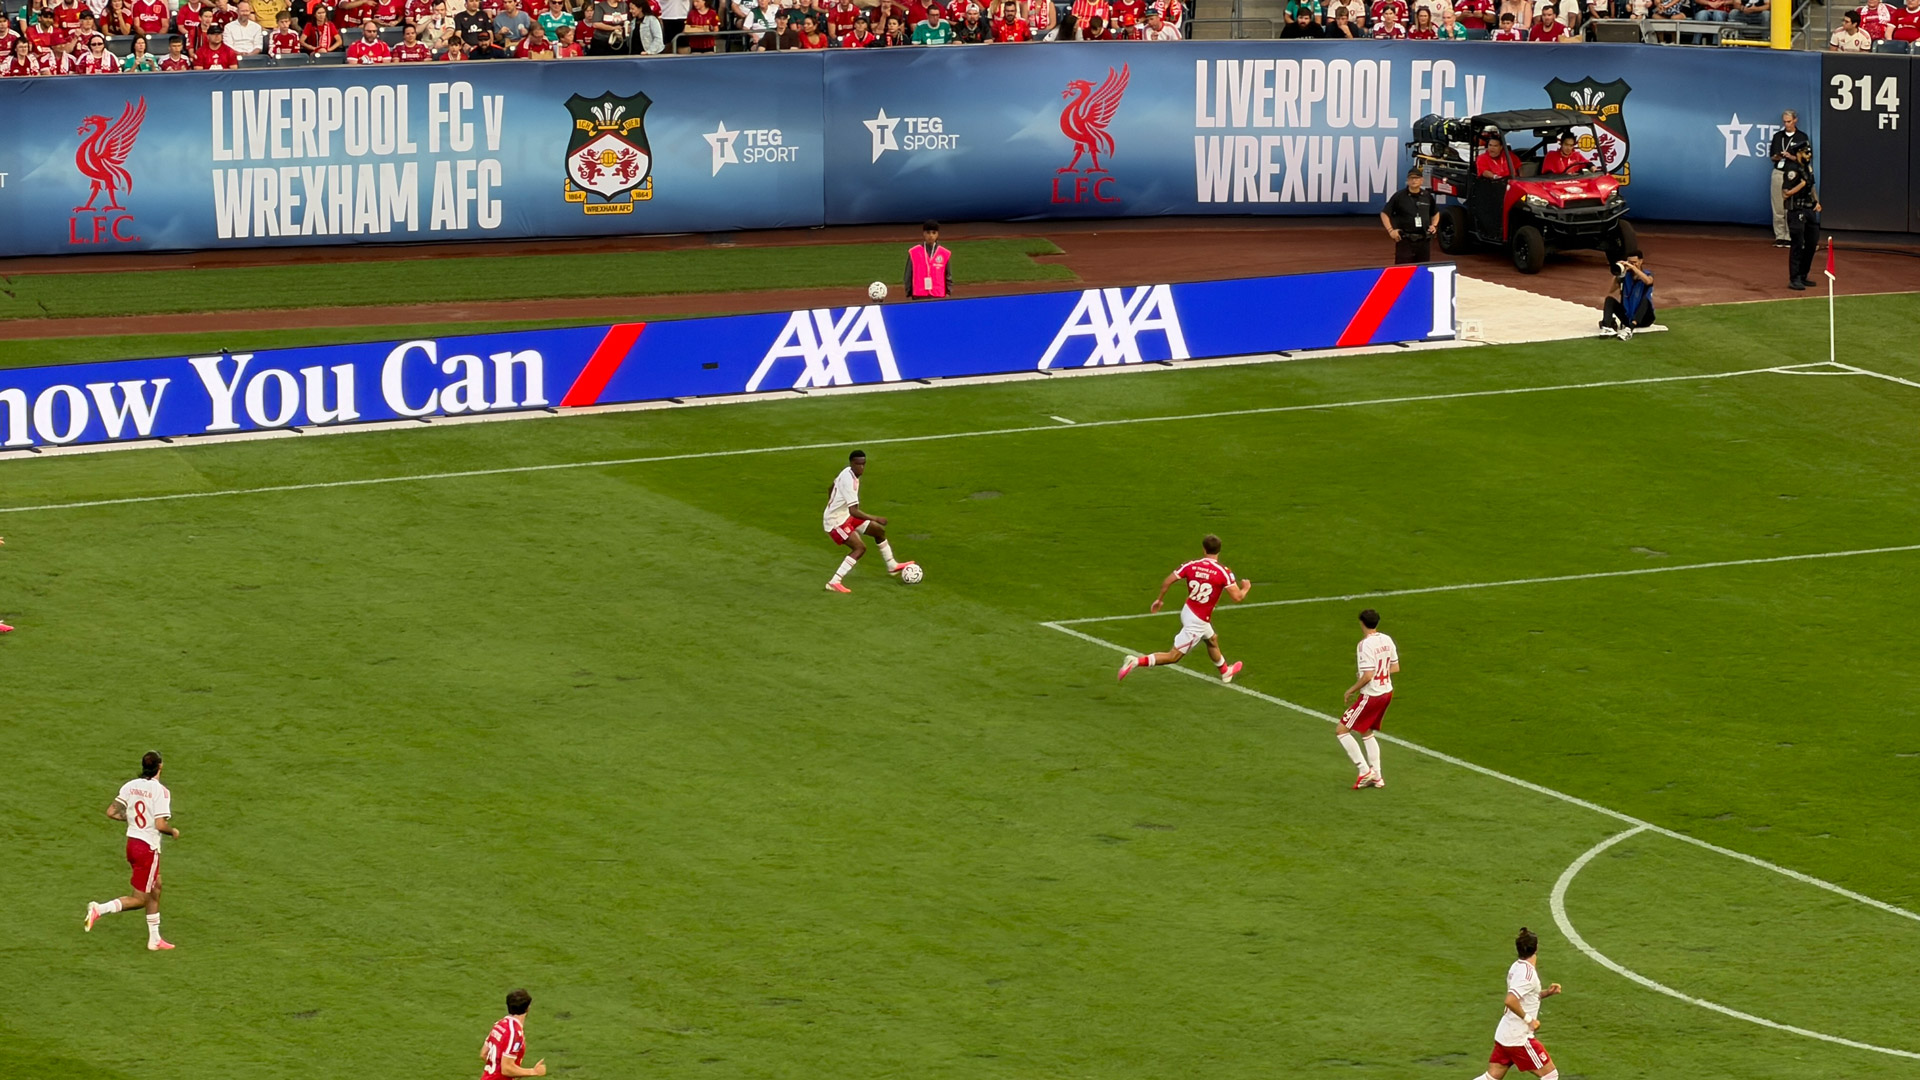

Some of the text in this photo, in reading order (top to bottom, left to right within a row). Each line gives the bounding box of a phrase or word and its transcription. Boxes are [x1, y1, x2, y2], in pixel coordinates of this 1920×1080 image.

[1195, 59, 1398, 128] LIVERPOOL
[1410, 59, 1456, 128] FC
[1829, 74, 1900, 112] 314
[212, 84, 417, 161] LIVERPOOL
[429, 81, 474, 153] FC
[903, 116, 943, 134] TEG
[1756, 124, 1785, 141] TE
[1878, 113, 1900, 130] FT
[743, 128, 783, 147] TEG
[903, 134, 960, 151] SPORT
[743, 146, 799, 163] SPORT
[1194, 135, 1398, 203] WREXHAM
[212, 158, 502, 239] WREXHAM AFC
[586, 203, 632, 213] WREXHAM AFC
[1037, 284, 1191, 370] AXA
[745, 305, 902, 393] AXA
[188, 353, 361, 431] You
[381, 340, 550, 418] Can
[1188, 580, 1213, 604] 28
[134, 800, 147, 829] 8
